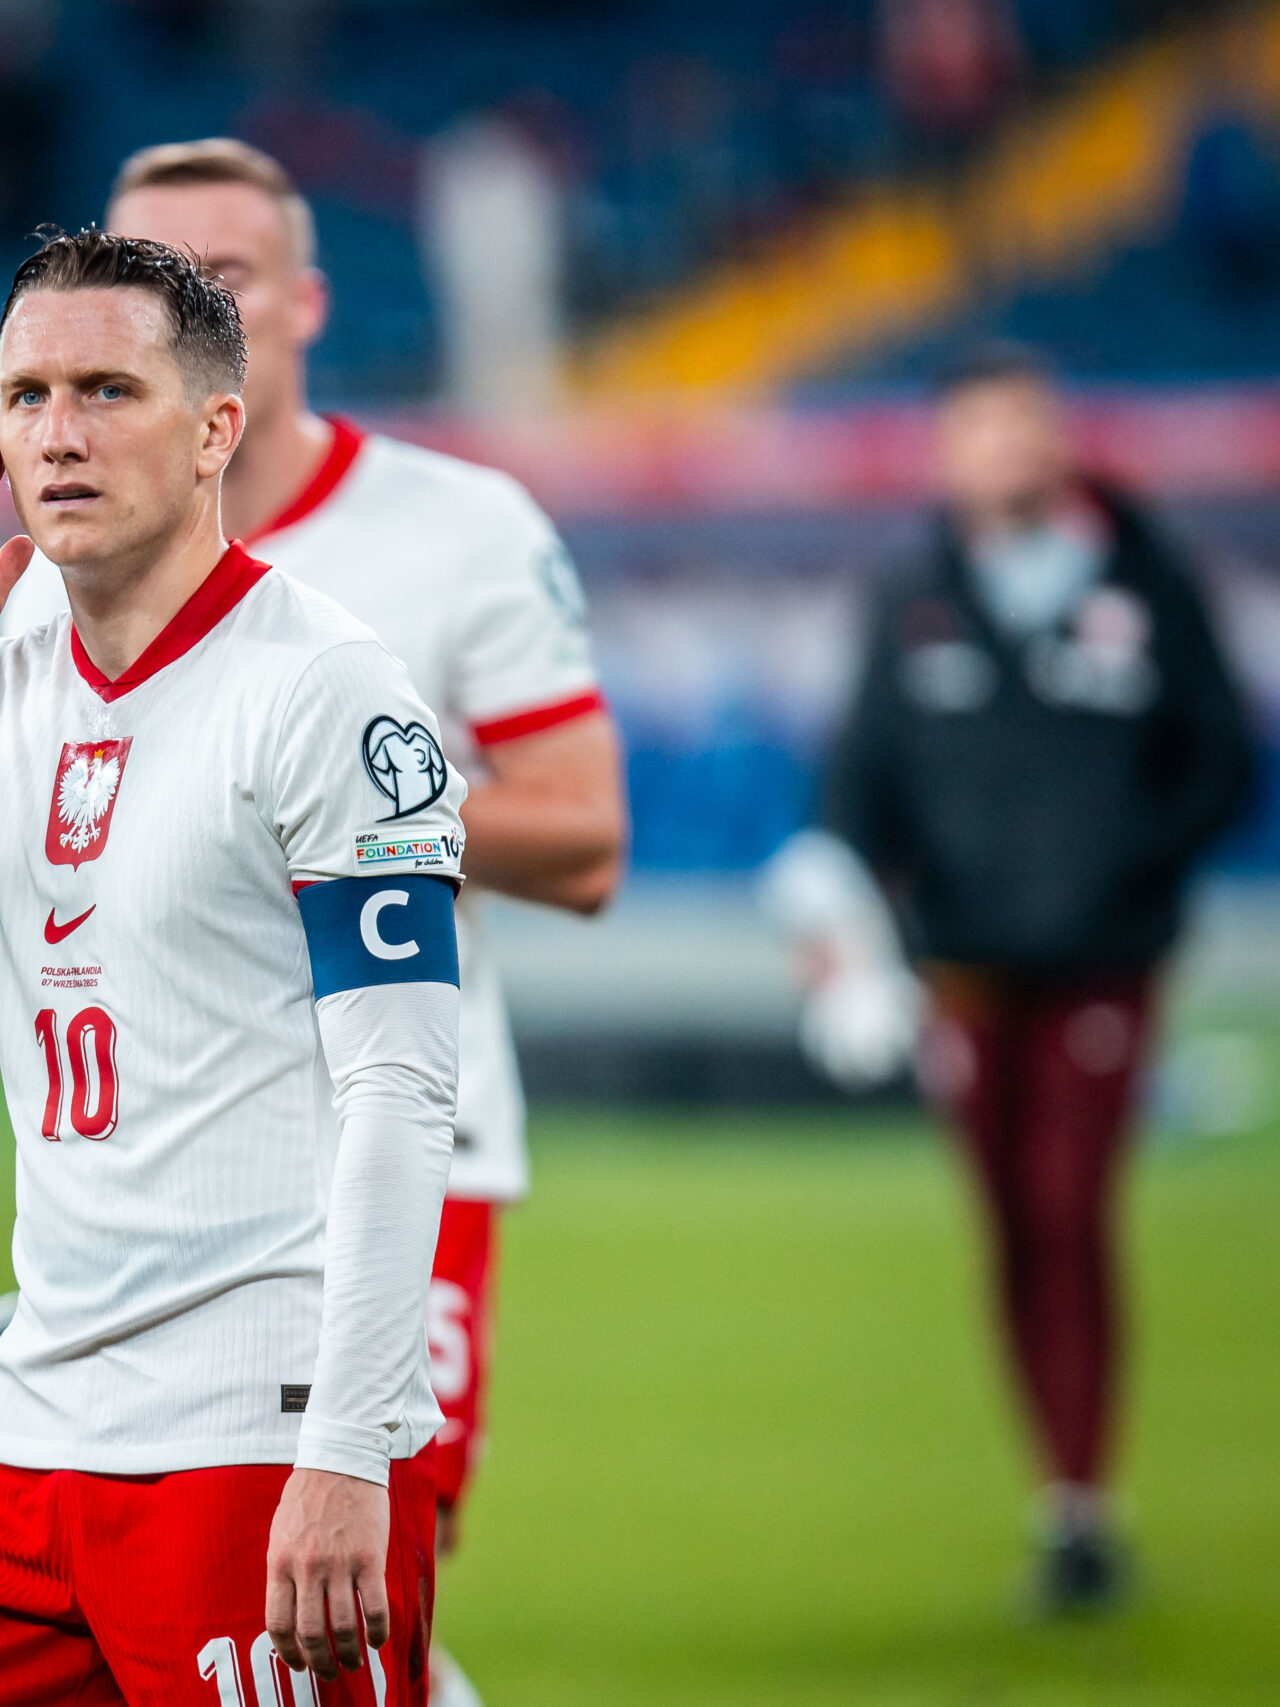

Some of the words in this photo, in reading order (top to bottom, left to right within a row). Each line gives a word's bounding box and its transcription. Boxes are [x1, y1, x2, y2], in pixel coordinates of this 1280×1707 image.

[355, 834, 379, 844] UEFA
[356, 843, 441, 859] FOUNDATION
[360, 889, 420, 960] C
[35, 1006, 119, 1141] 10
